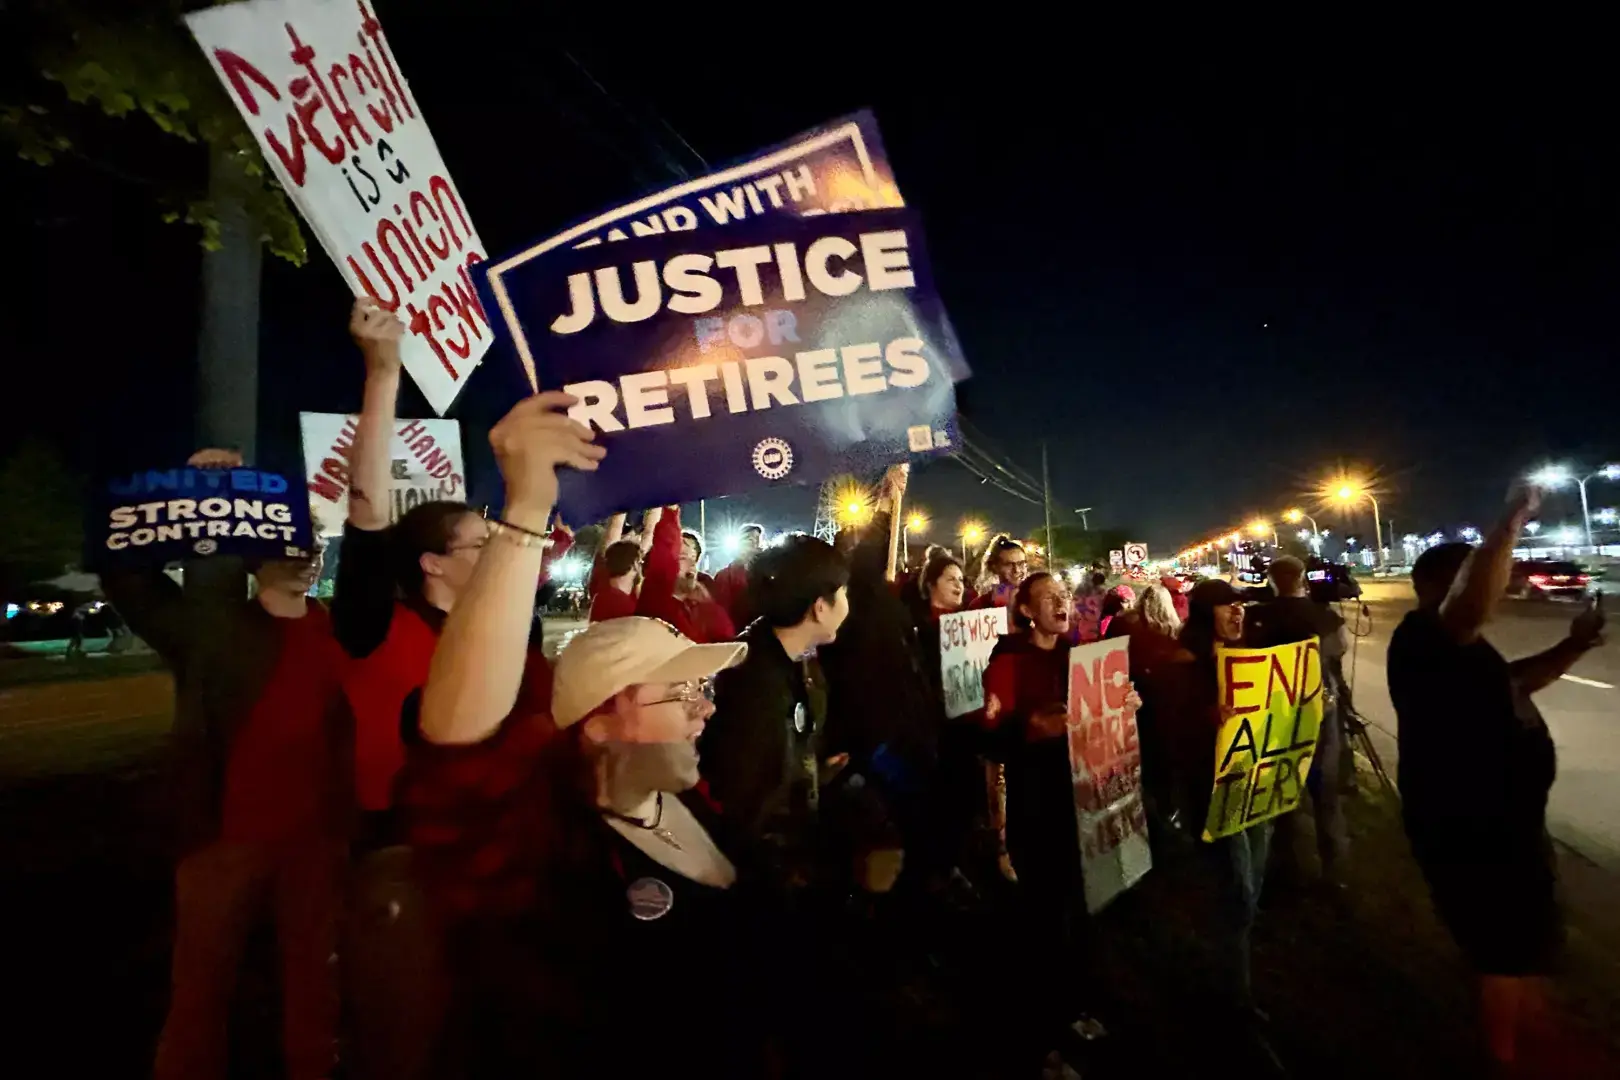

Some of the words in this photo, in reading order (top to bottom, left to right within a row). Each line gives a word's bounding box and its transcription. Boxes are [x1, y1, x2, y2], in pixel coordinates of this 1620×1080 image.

[213, 0, 415, 187] Detroit
[340, 154, 380, 212] is
[377, 138, 410, 184] a
[698, 165, 817, 225] WITH
[346, 175, 476, 312] union
[551, 230, 916, 334] JUSTICE
[694, 309, 801, 353] FOR
[563, 338, 930, 433] RETIREES
[109, 468, 288, 494] UNITED
[398, 419, 462, 496] HANDS
[106, 520, 297, 550] CONTRACT
[109, 498, 292, 529] STRONG
[942, 616, 967, 651] get
[968, 613, 1000, 641] wise
[1071, 649, 1131, 726] NO
[1225, 642, 1323, 714] END
[1220, 706, 1315, 773] ALL
[1216, 751, 1314, 831] TIERS
